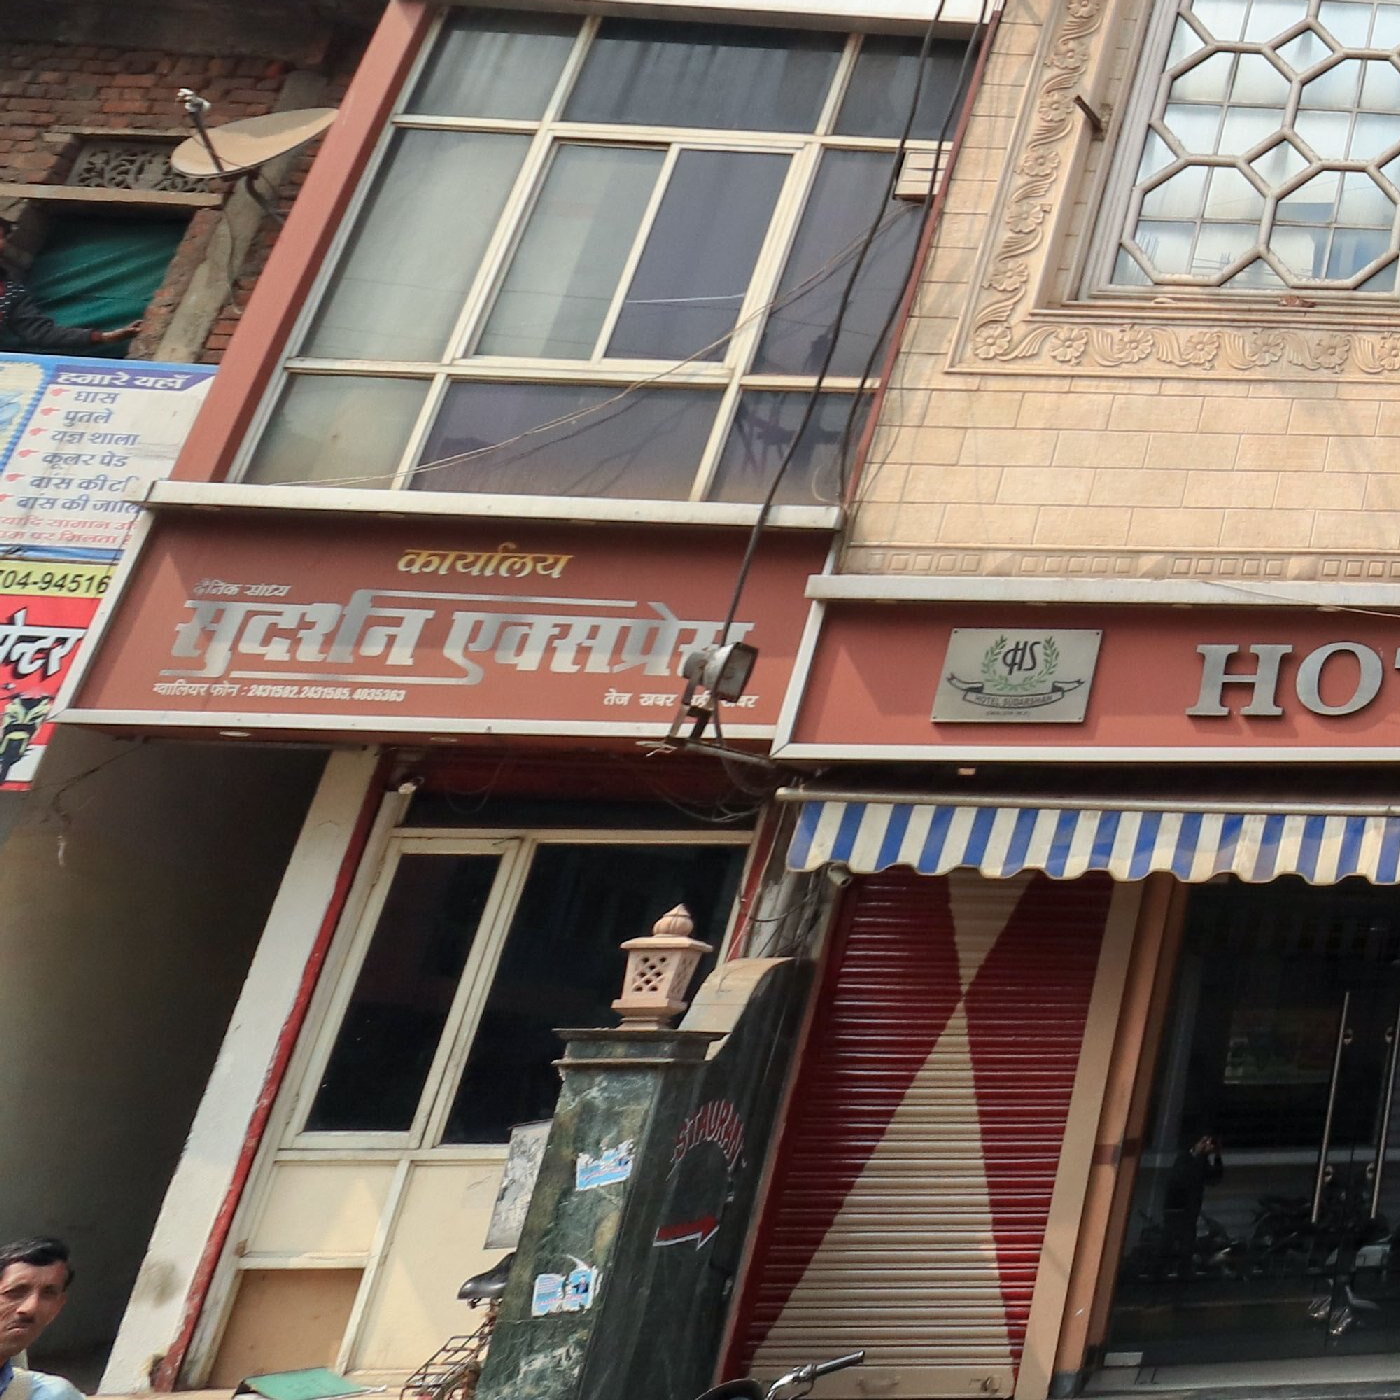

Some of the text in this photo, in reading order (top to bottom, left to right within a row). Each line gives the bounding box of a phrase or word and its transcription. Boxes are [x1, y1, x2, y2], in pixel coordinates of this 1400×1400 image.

[56, 371, 131, 385] हमारे
[74, 392, 120, 405] घास
[63, 407, 113, 427] पुतले
[51, 429, 140, 447] यज्ञ शाला
[42, 451, 130, 470] कूलर पेड
[61, 494, 89, 512] की
[398, 541, 574, 579] कार्यालय
[170, 588, 436, 678] सुदर्शन
[152, 678, 210, 696] ग्वालियर
[209, 680, 241, 697] फोन
[603, 688, 633, 706] तेज
[639, 693, 678, 707] खबर
[720, 695, 759, 708] बर
